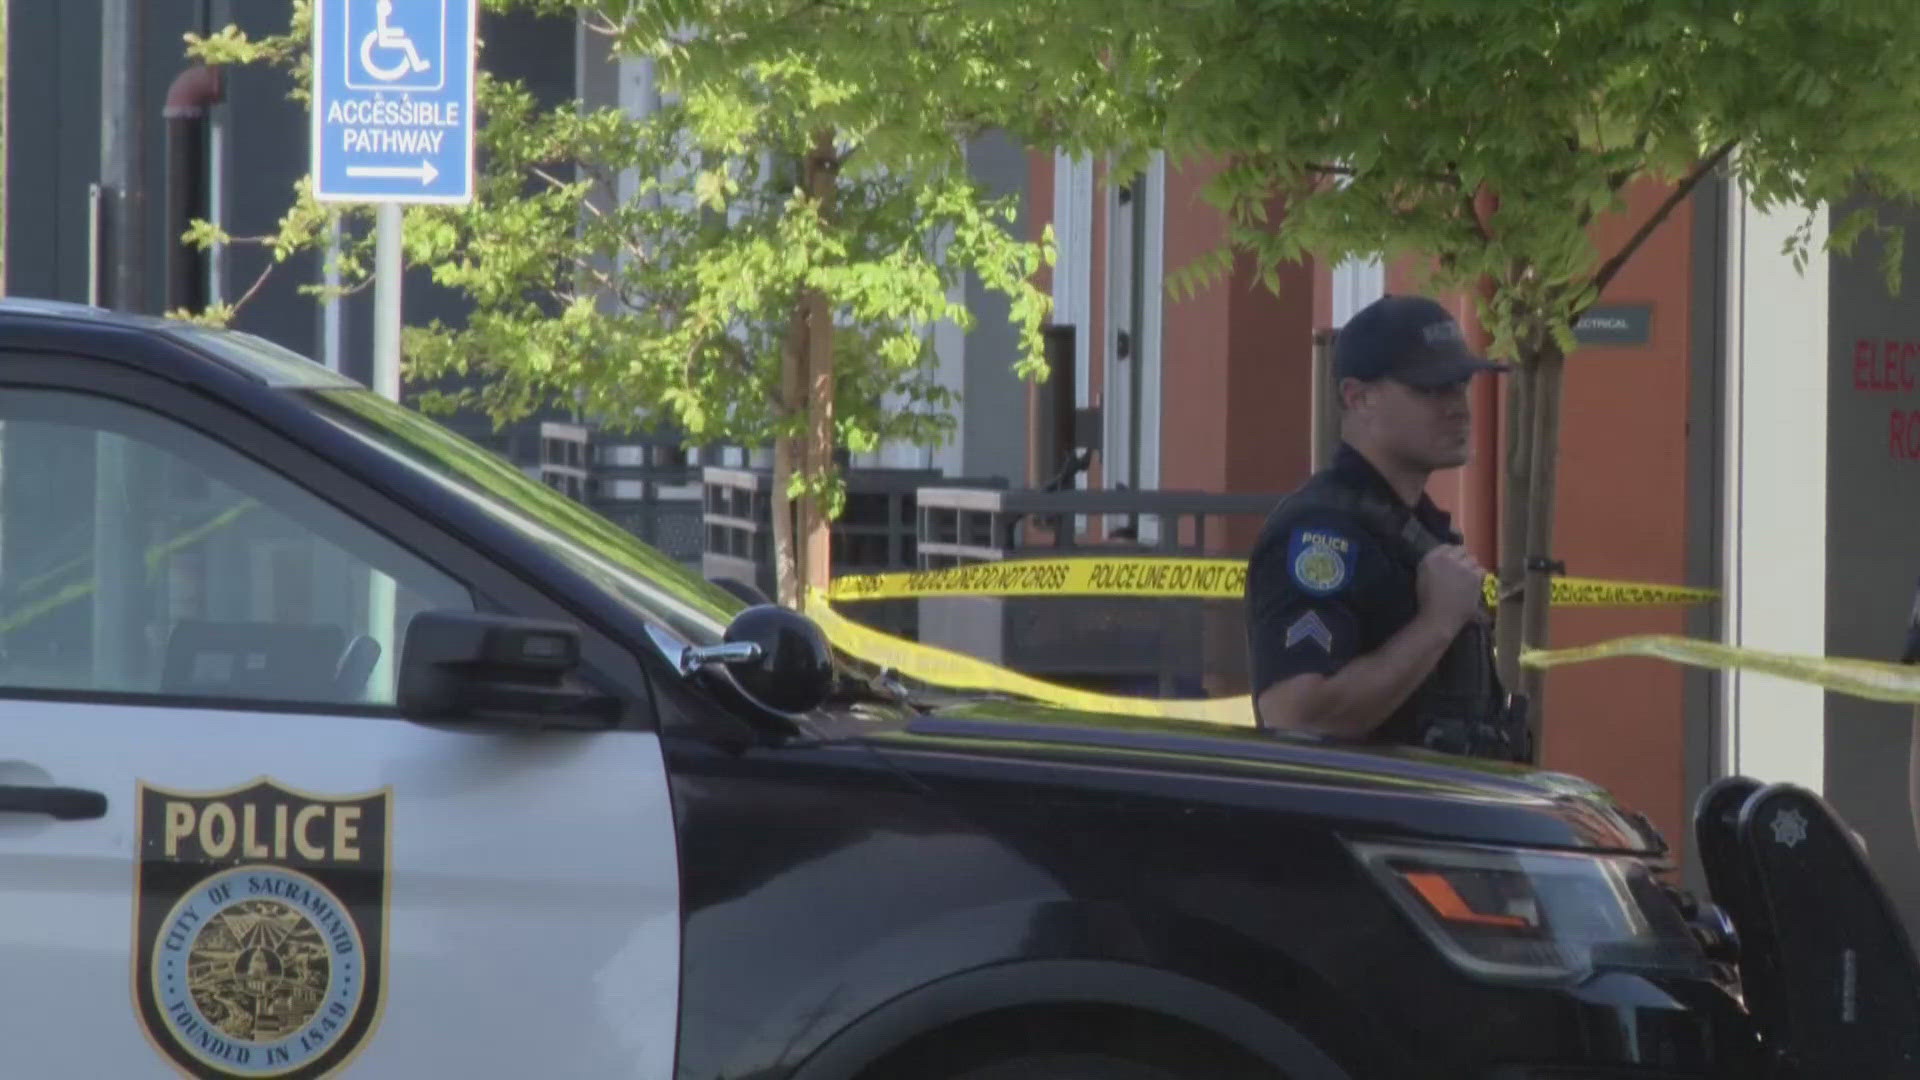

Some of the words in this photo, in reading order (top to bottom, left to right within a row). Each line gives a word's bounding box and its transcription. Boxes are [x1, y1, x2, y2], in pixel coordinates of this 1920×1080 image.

[327, 99, 460, 126] ACCESSIBLE
[342, 127, 444, 153] PATHWAY
[1854, 337, 1920, 391] ELEC
[1302, 531, 1349, 553] POLICE
[1021, 564, 1070, 590] CROSS
[1088, 563, 1137, 589] POLICE
[1136, 564, 1170, 590] LINE
[1168, 564, 1193, 590] DO
[1191, 566, 1225, 592] NOT
[164, 801, 362, 862] POLICE
[166, 905, 201, 952] CITY
[207, 882, 232, 906] OF
[248, 877, 354, 955] SACRAMENTO
[169, 1000, 251, 1066] FOUNDED
[266, 1045, 291, 1066] IN
[300, 1001, 348, 1053] 1849
